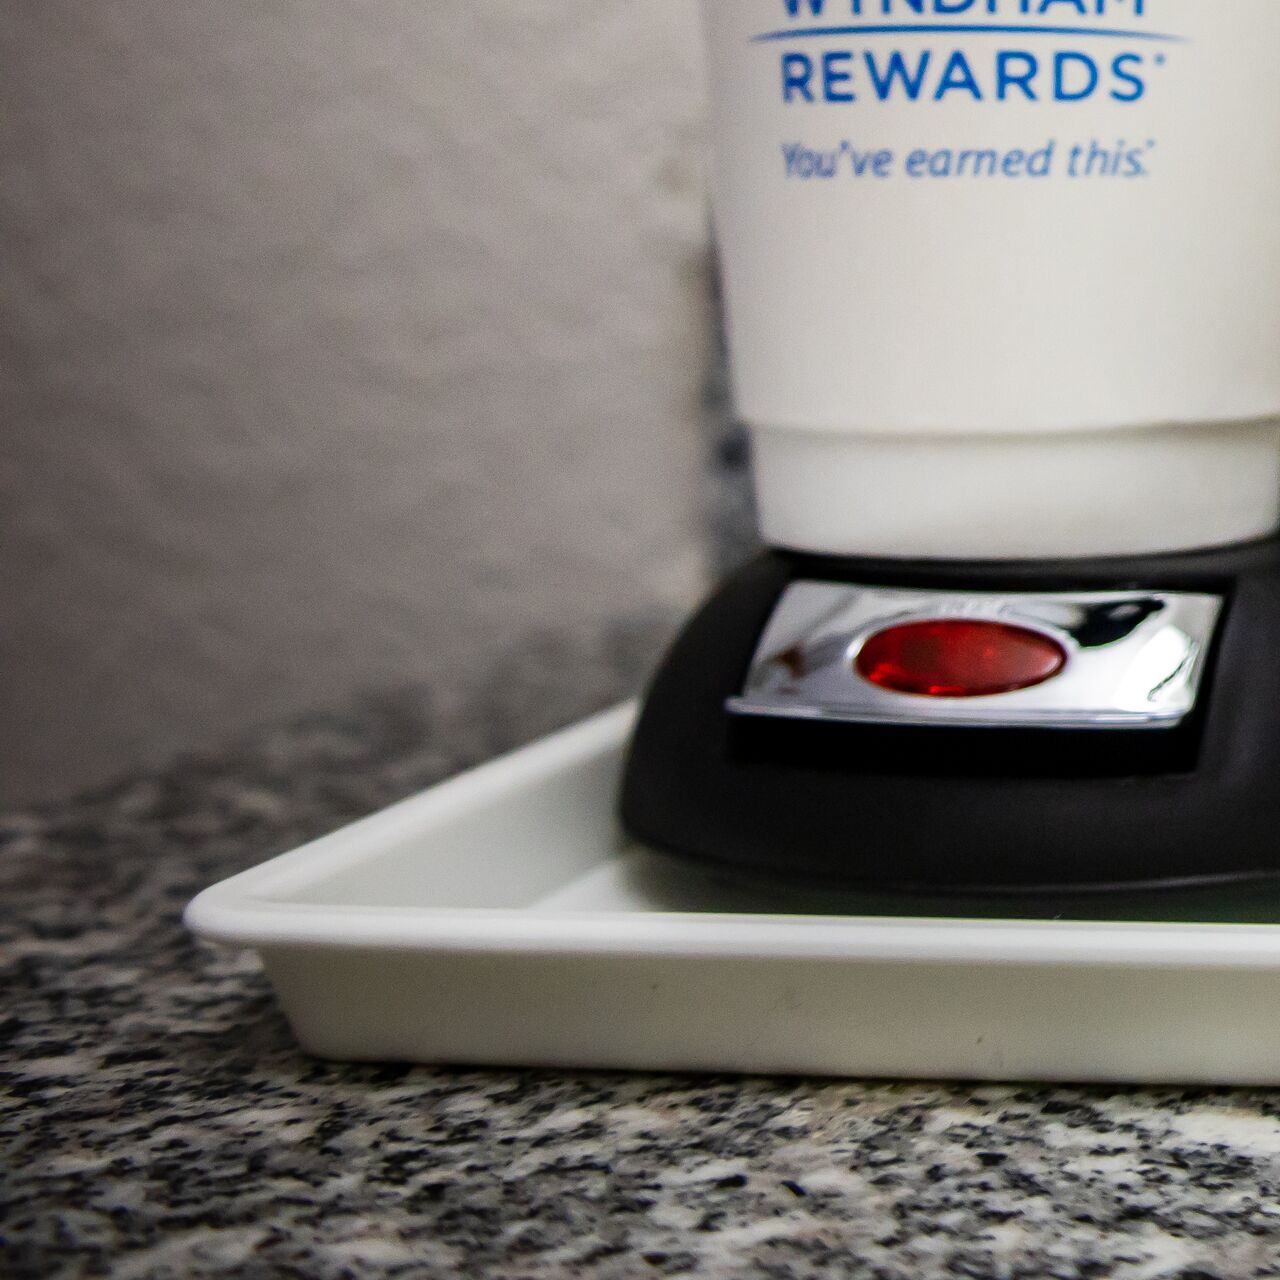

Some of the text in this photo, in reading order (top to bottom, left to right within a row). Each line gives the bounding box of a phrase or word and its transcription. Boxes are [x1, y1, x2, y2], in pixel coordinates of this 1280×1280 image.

[780, 49, 1146, 104] REWARDS
[780, 140, 894, 179] You've
[904, 139, 1056, 179] earned
